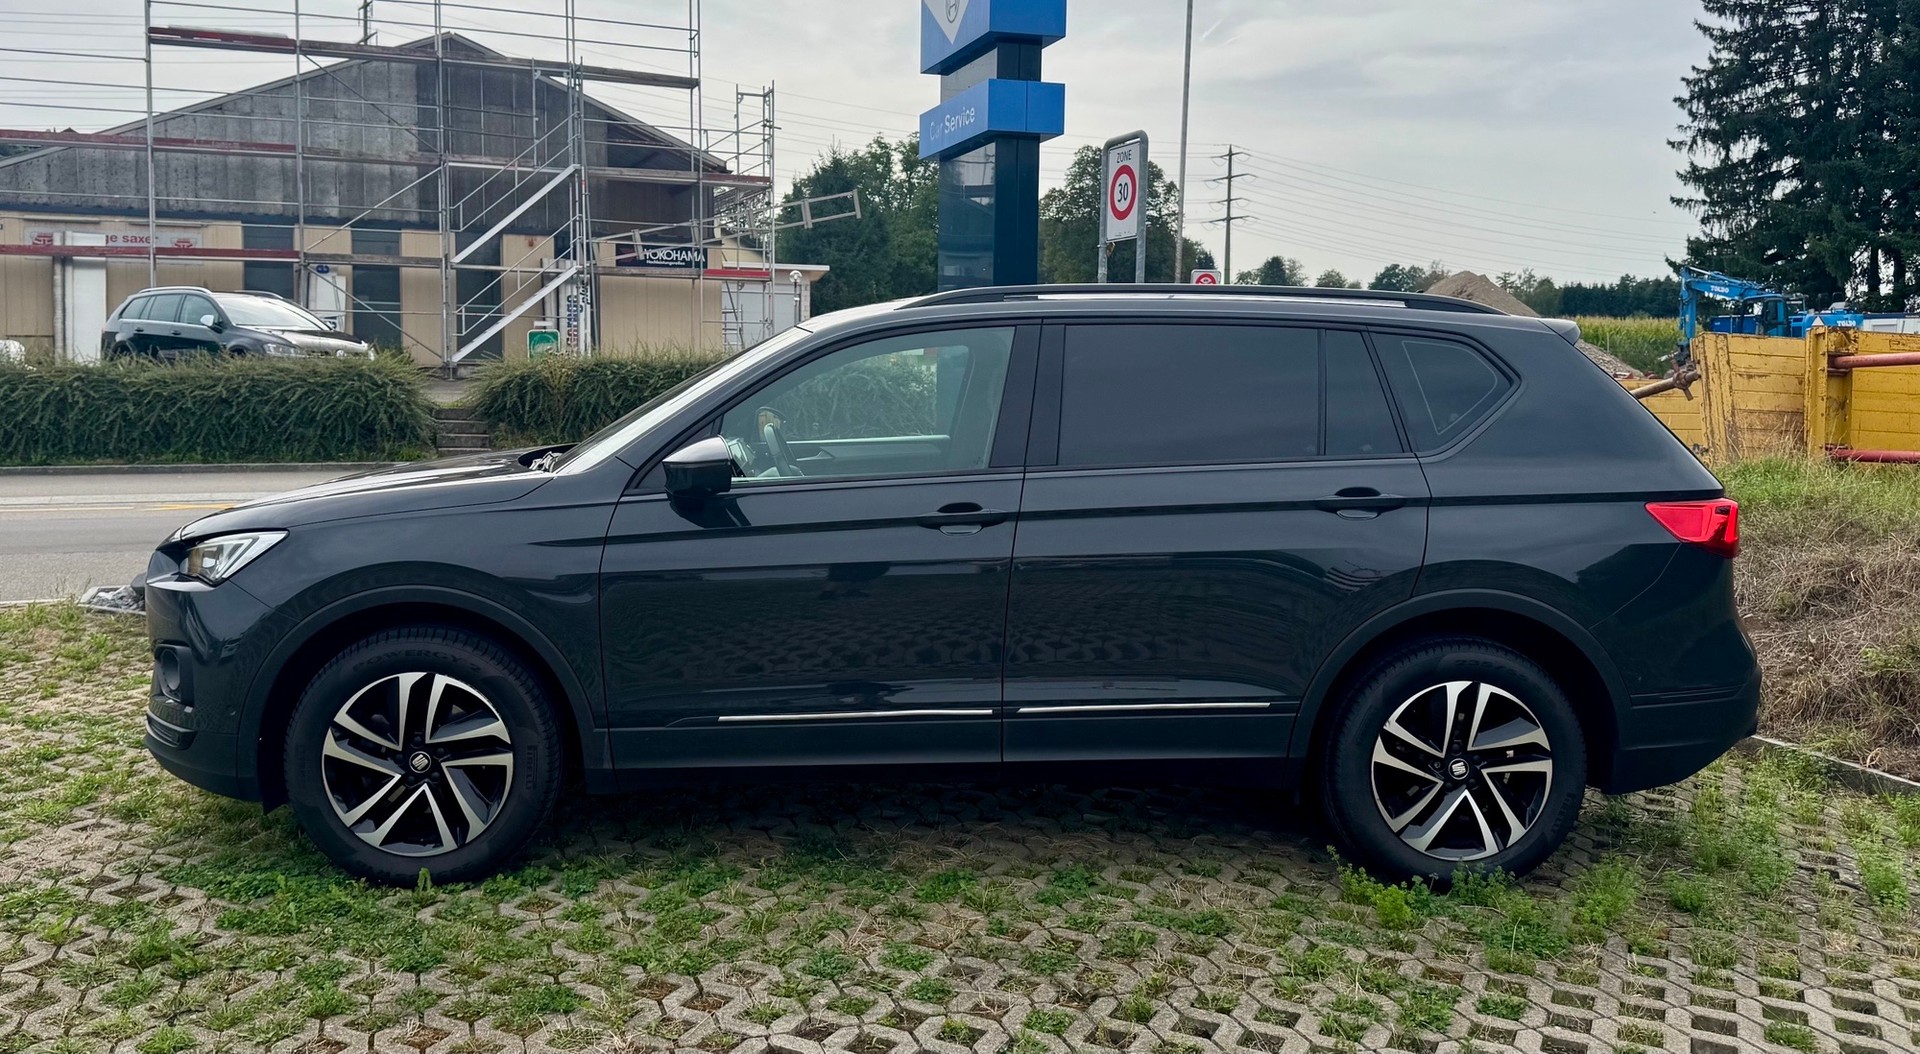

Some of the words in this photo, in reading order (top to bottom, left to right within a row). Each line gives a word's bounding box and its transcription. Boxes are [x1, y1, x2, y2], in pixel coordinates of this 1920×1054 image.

[929, 120, 943, 141] Car
[944, 105, 975, 134] Service
[1116, 149, 1132, 164] ZONE
[1117, 182, 1129, 203] 30
[643, 248, 706, 263] YOKOHAMA
[1710, 285, 1730, 294] TOLDO
[1836, 320, 1857, 328] TOLDO
